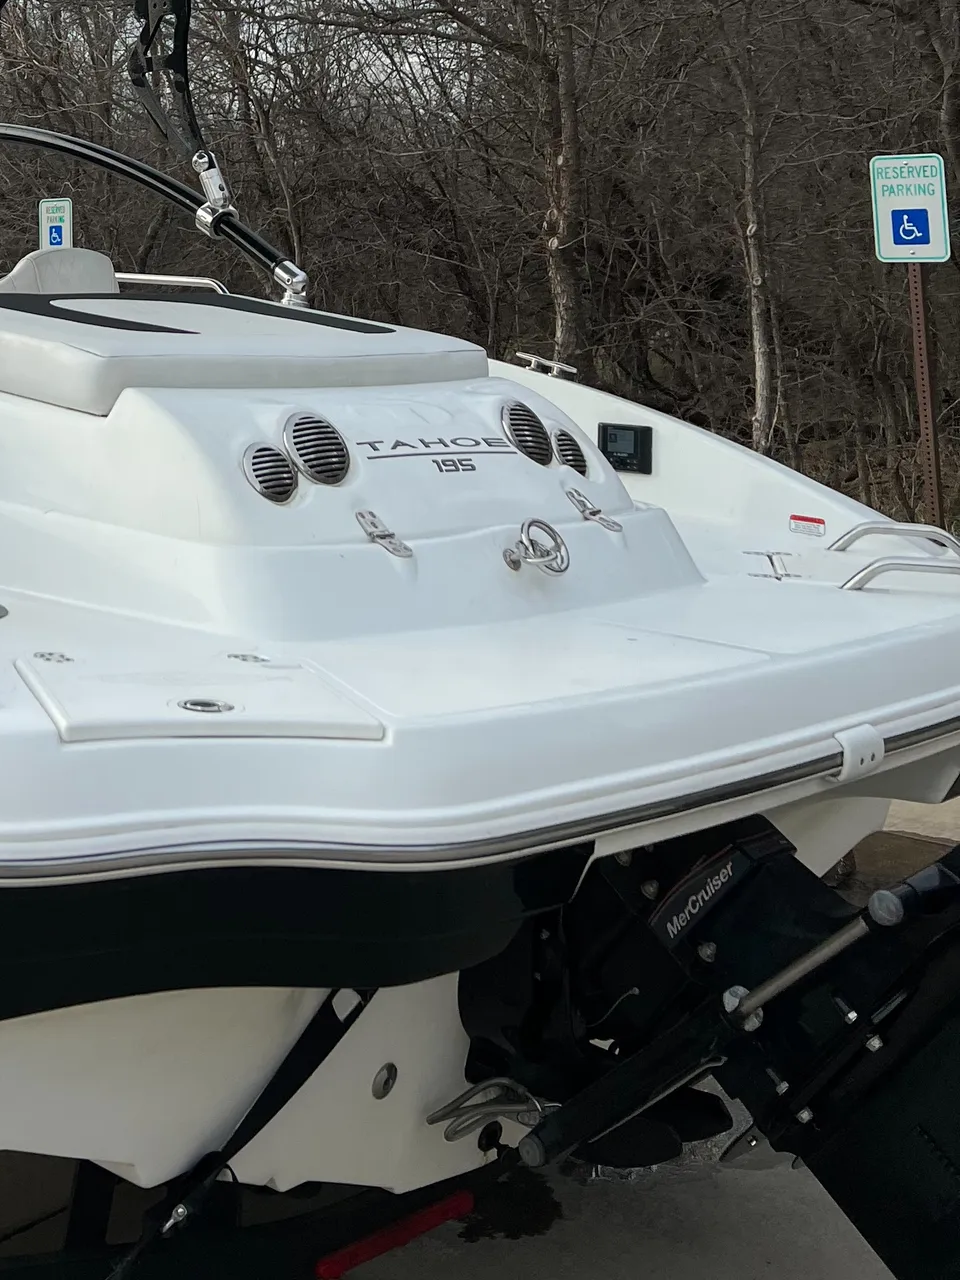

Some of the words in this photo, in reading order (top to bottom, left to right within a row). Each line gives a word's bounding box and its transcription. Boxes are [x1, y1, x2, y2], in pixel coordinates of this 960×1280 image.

[876, 165, 938, 180] RESERVED
[881, 183, 936, 197] PARKING
[355, 437, 511, 452] TAHOE
[431, 458, 477, 473] 195
[666, 861, 734, 939] MerCruiser
